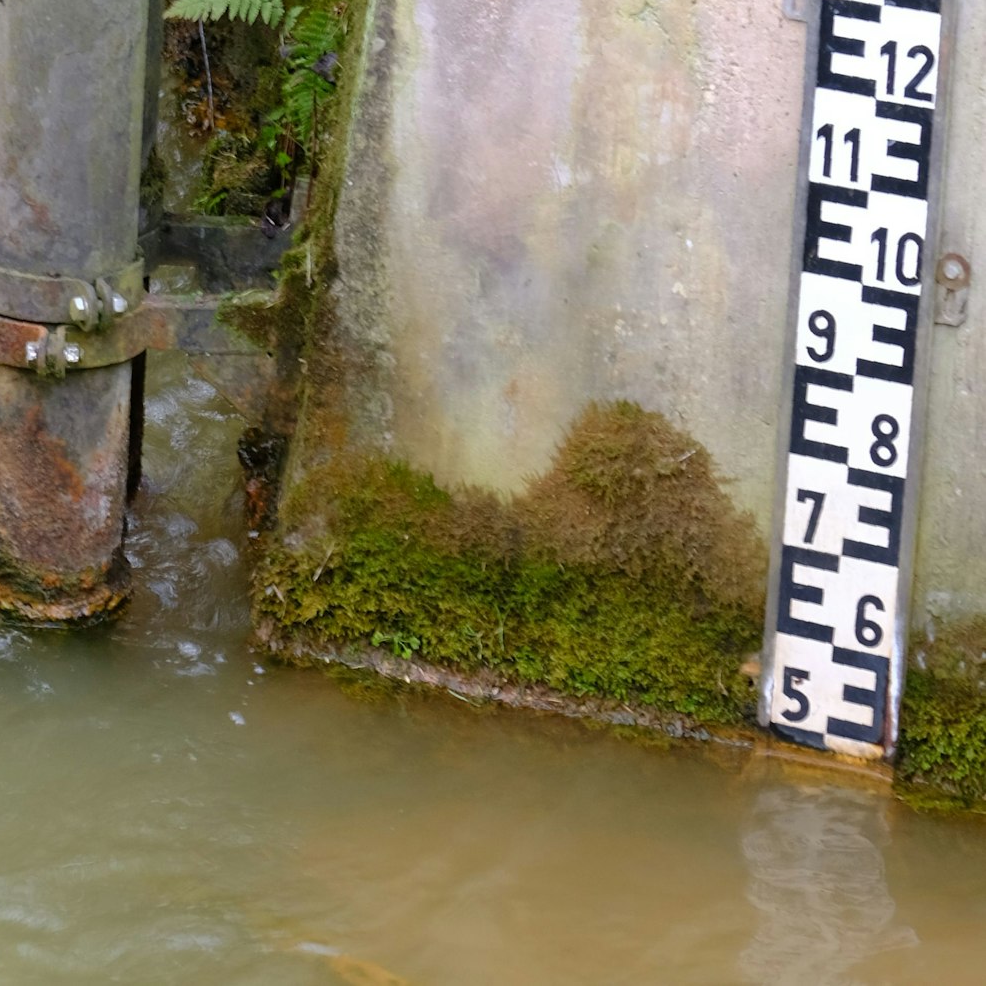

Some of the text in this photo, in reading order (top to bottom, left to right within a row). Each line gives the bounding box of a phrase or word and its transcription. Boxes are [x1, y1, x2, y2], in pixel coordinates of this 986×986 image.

[880, 40, 935, 103] 12
[816, 123, 861, 183] 11
[870, 227, 924, 286] 10
[806, 309, 837, 363] 9
[870, 414, 899, 467] 8
[797, 488, 827, 544] 7
[855, 594, 886, 647] 6
[781, 666, 811, 722] 5
